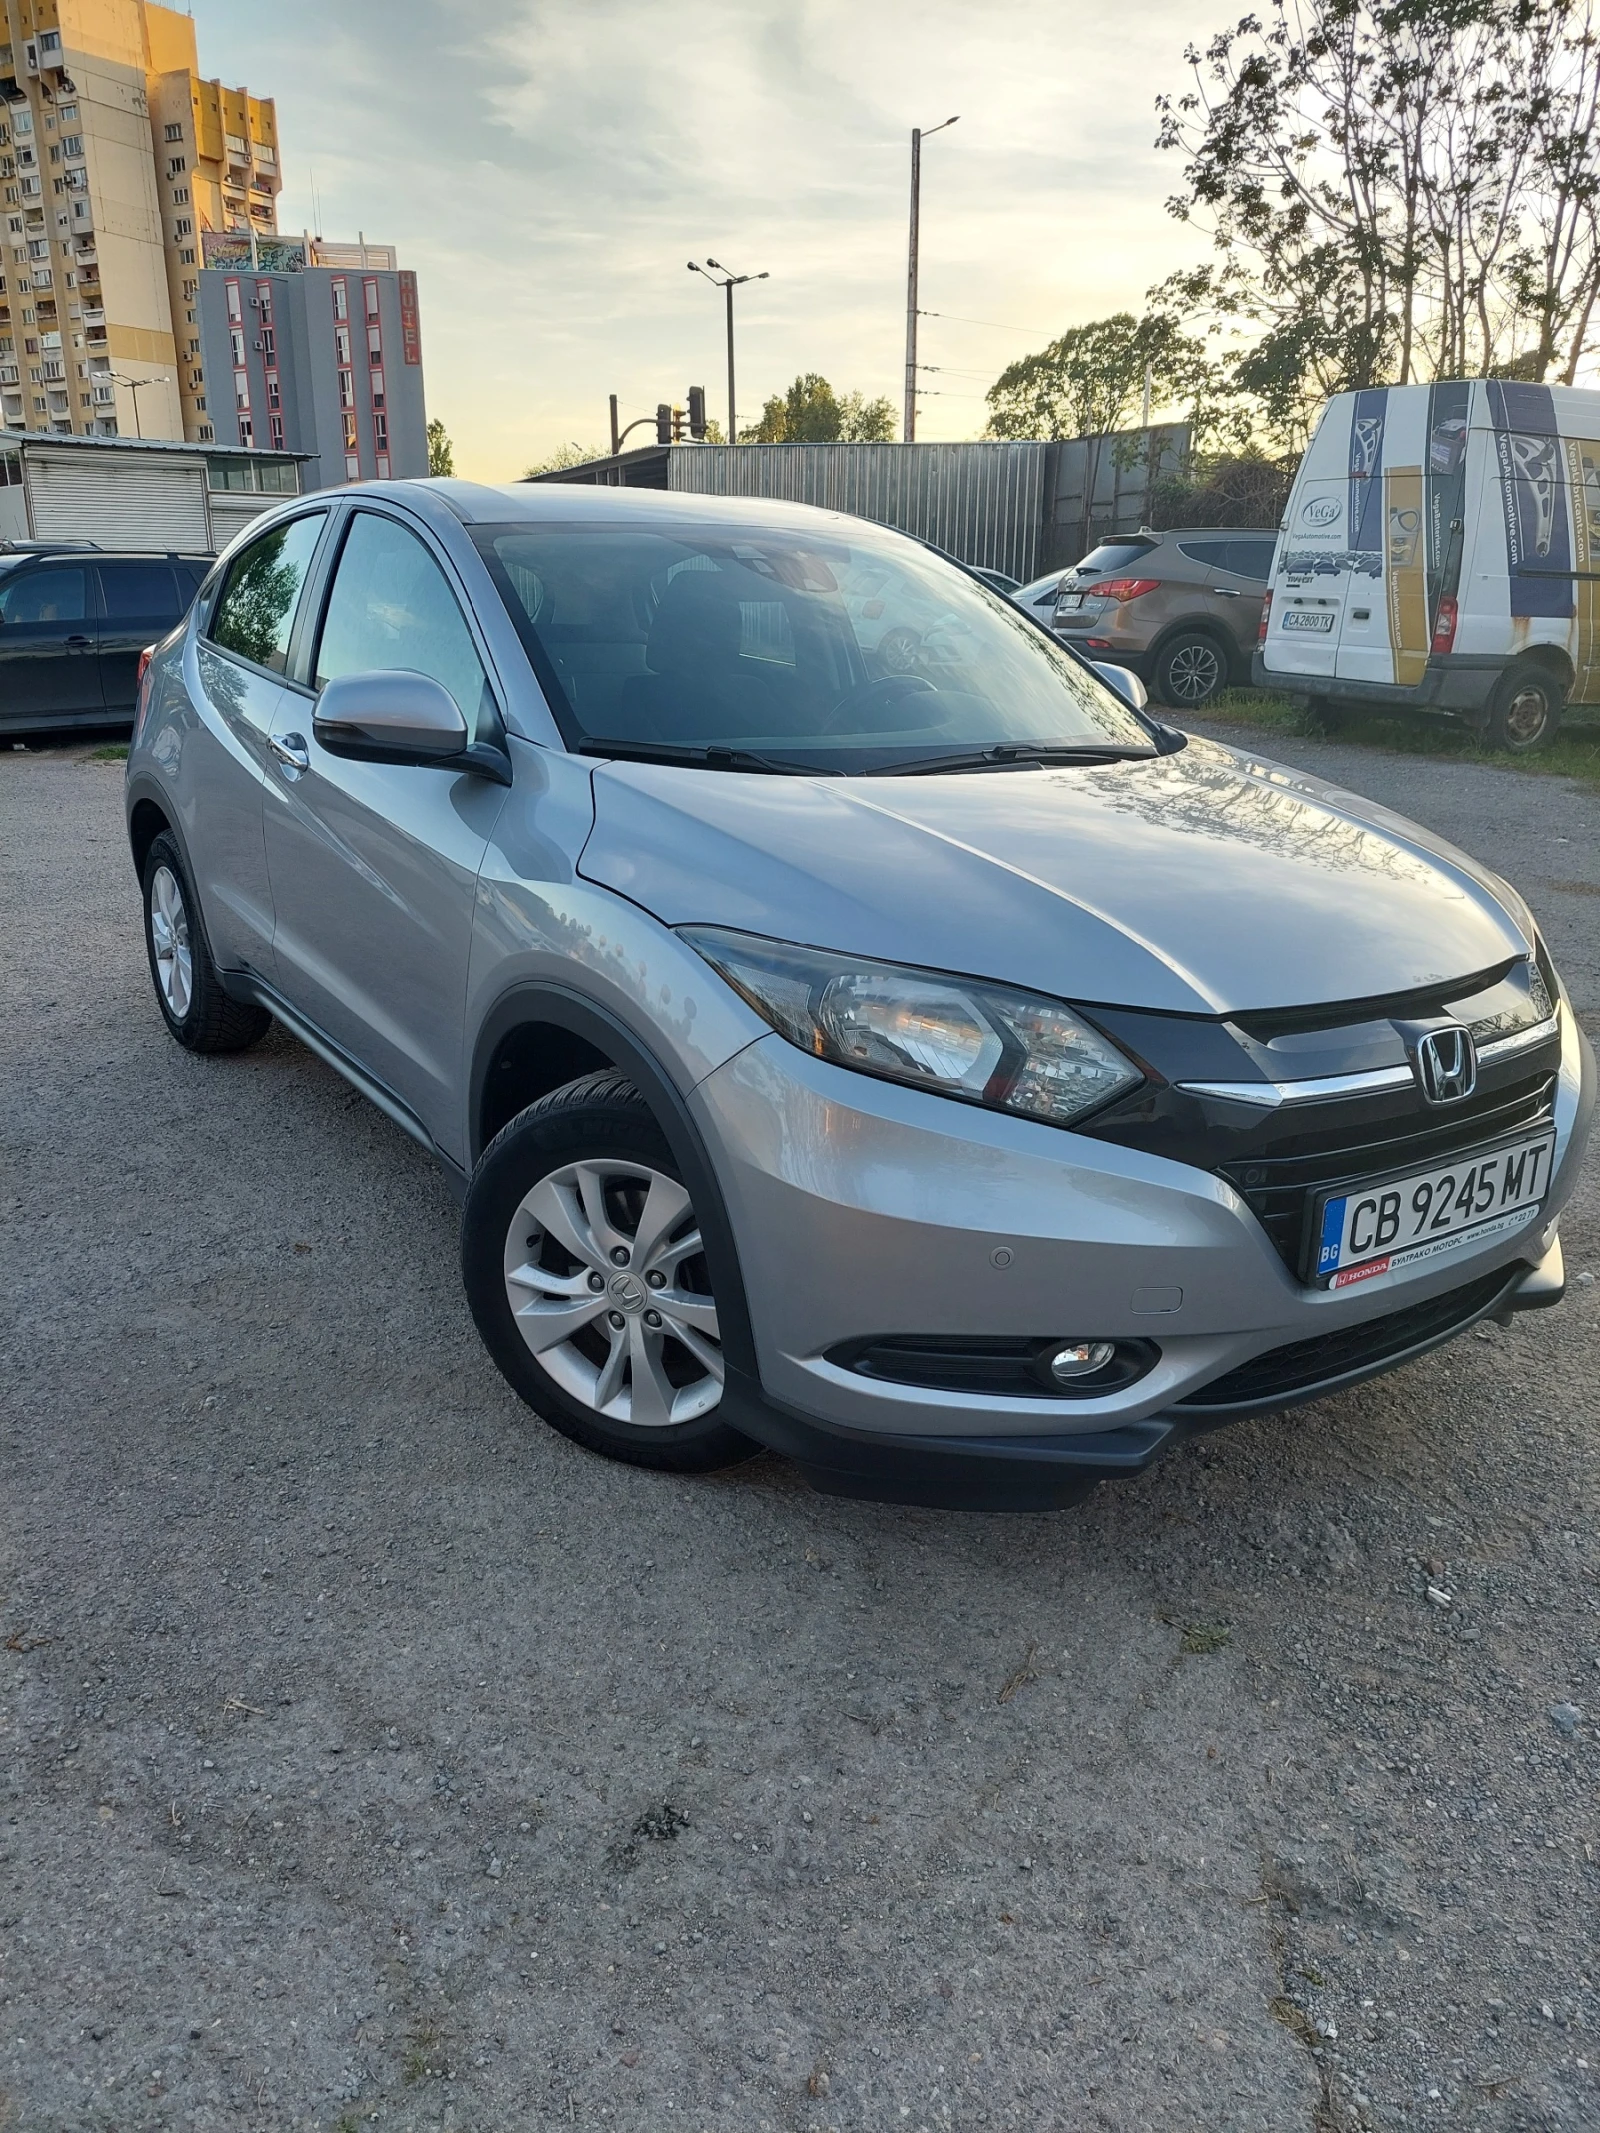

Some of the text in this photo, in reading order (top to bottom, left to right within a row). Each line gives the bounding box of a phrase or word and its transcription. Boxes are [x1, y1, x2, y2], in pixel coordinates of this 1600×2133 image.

[400, 272, 418, 362] HOTEL
[1433, 492, 1442, 568] VegaBatteries.com
[1498, 433, 1519, 565] VegaAutomotive.com
[1567, 442, 1586, 562] VegaLubricants.com
[1288, 614, 1300, 626] CA
[1320, 616, 1331, 628] TK
[1391, 569, 1403, 648] VegaLubricants.com
[1349, 1142, 1548, 1254] CB 9245 MT
[1466, 1222, 1505, 1241] www.honda.bg
[1320, 1243, 1339, 1263] BG
[1347, 1263, 1388, 1281] HONDA
